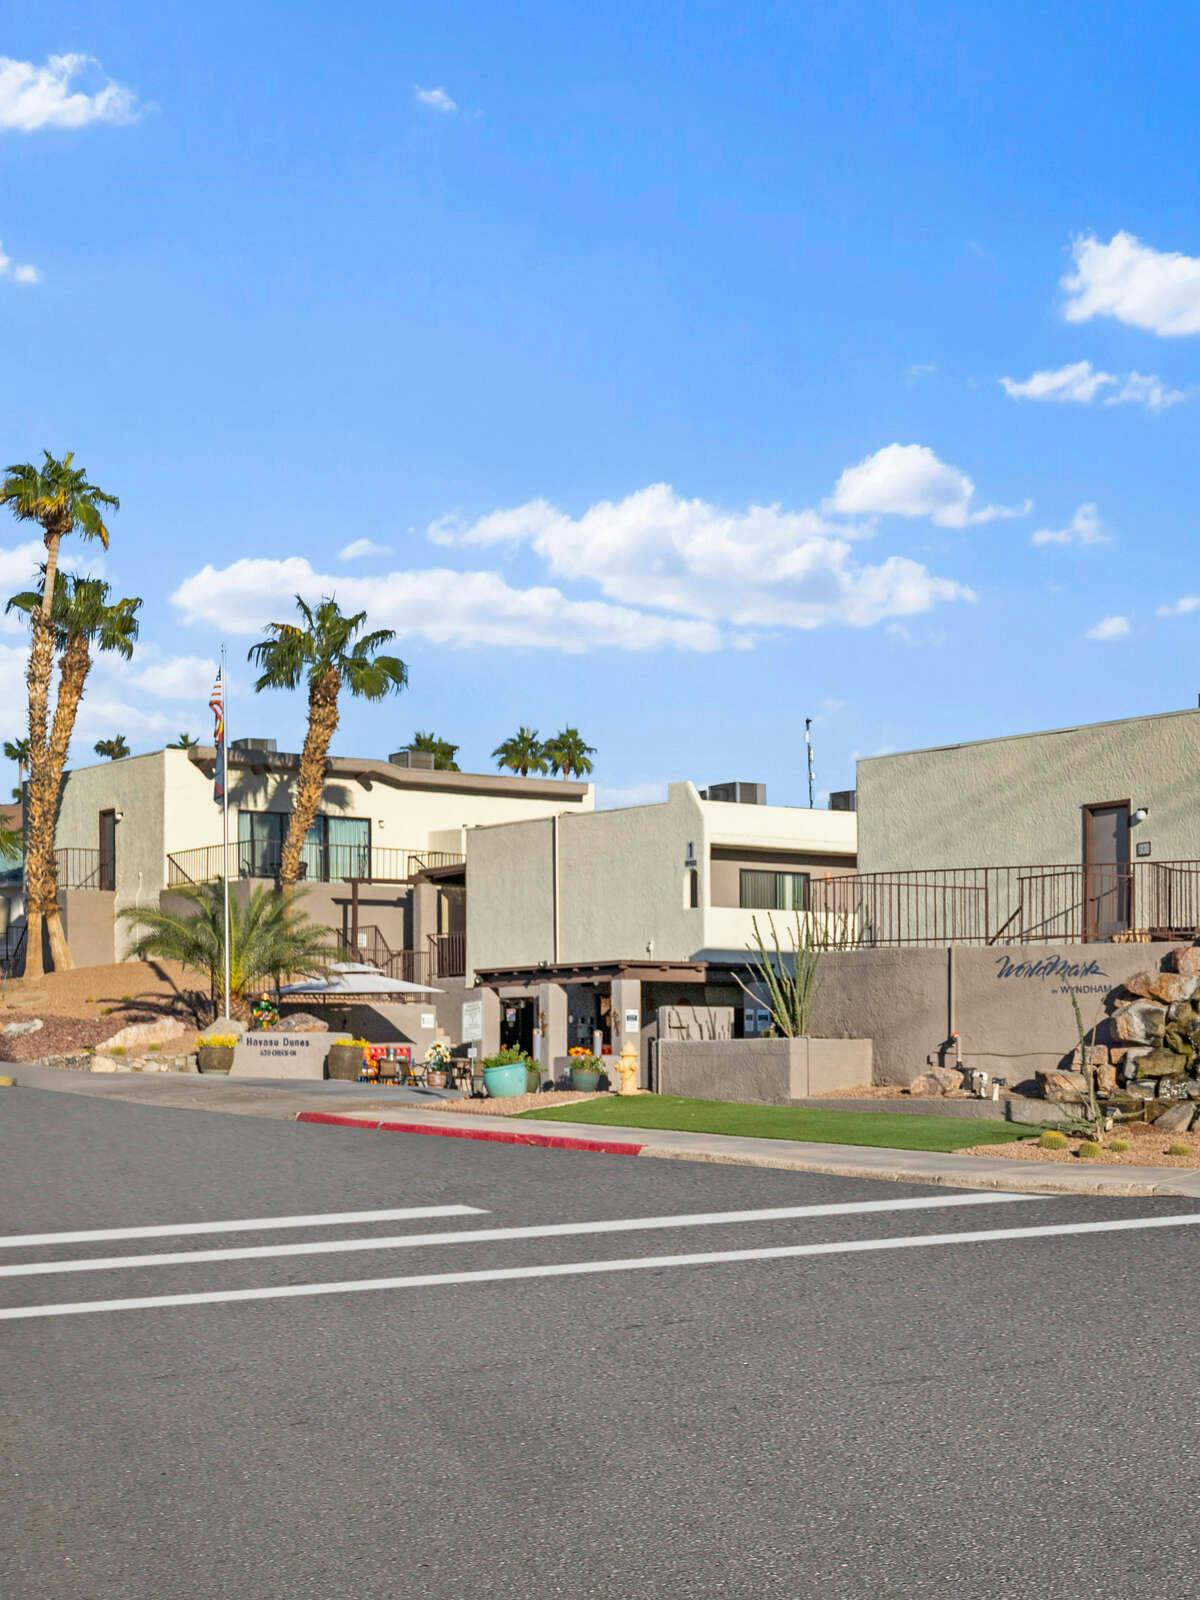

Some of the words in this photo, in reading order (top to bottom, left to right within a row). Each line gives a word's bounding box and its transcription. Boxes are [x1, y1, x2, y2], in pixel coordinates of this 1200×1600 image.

[995, 954, 1110, 981] WorldMark
[1060, 984, 1112, 994] WYNDHAM
[246, 1037, 279, 1047] Havasu
[283, 1037, 310, 1047] Dunes
